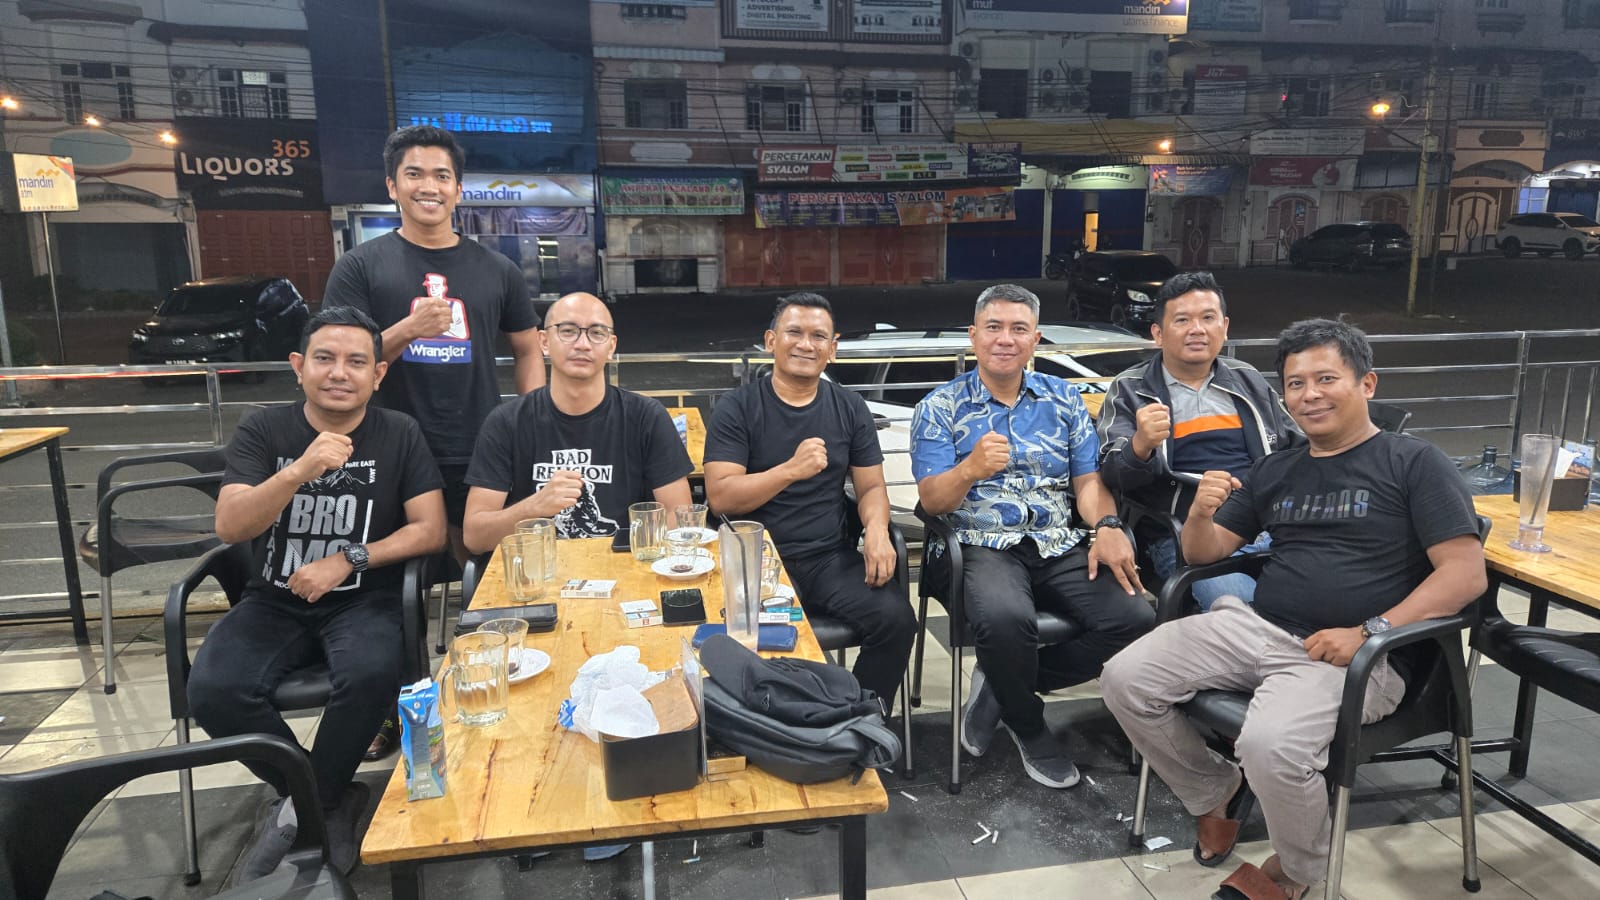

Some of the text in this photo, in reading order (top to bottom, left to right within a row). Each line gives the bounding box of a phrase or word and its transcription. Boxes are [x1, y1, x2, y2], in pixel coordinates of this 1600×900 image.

[1123, 4, 1161, 16] mandiri
[271, 139, 311, 158] 365
[763, 152, 832, 161] PERCETAKAN
[179, 151, 295, 181] LIQUORS
[18, 175, 54, 188] mandiri
[461, 186, 522, 201] mandiri
[786, 192, 885, 206] PERCETAKAN
[886, 190, 946, 205] SYALOM
[408, 343, 457, 362] Wrangler
[360, 460, 376, 468] EAST
[555, 452, 589, 466] BAD
[287, 493, 357, 536] BRO
